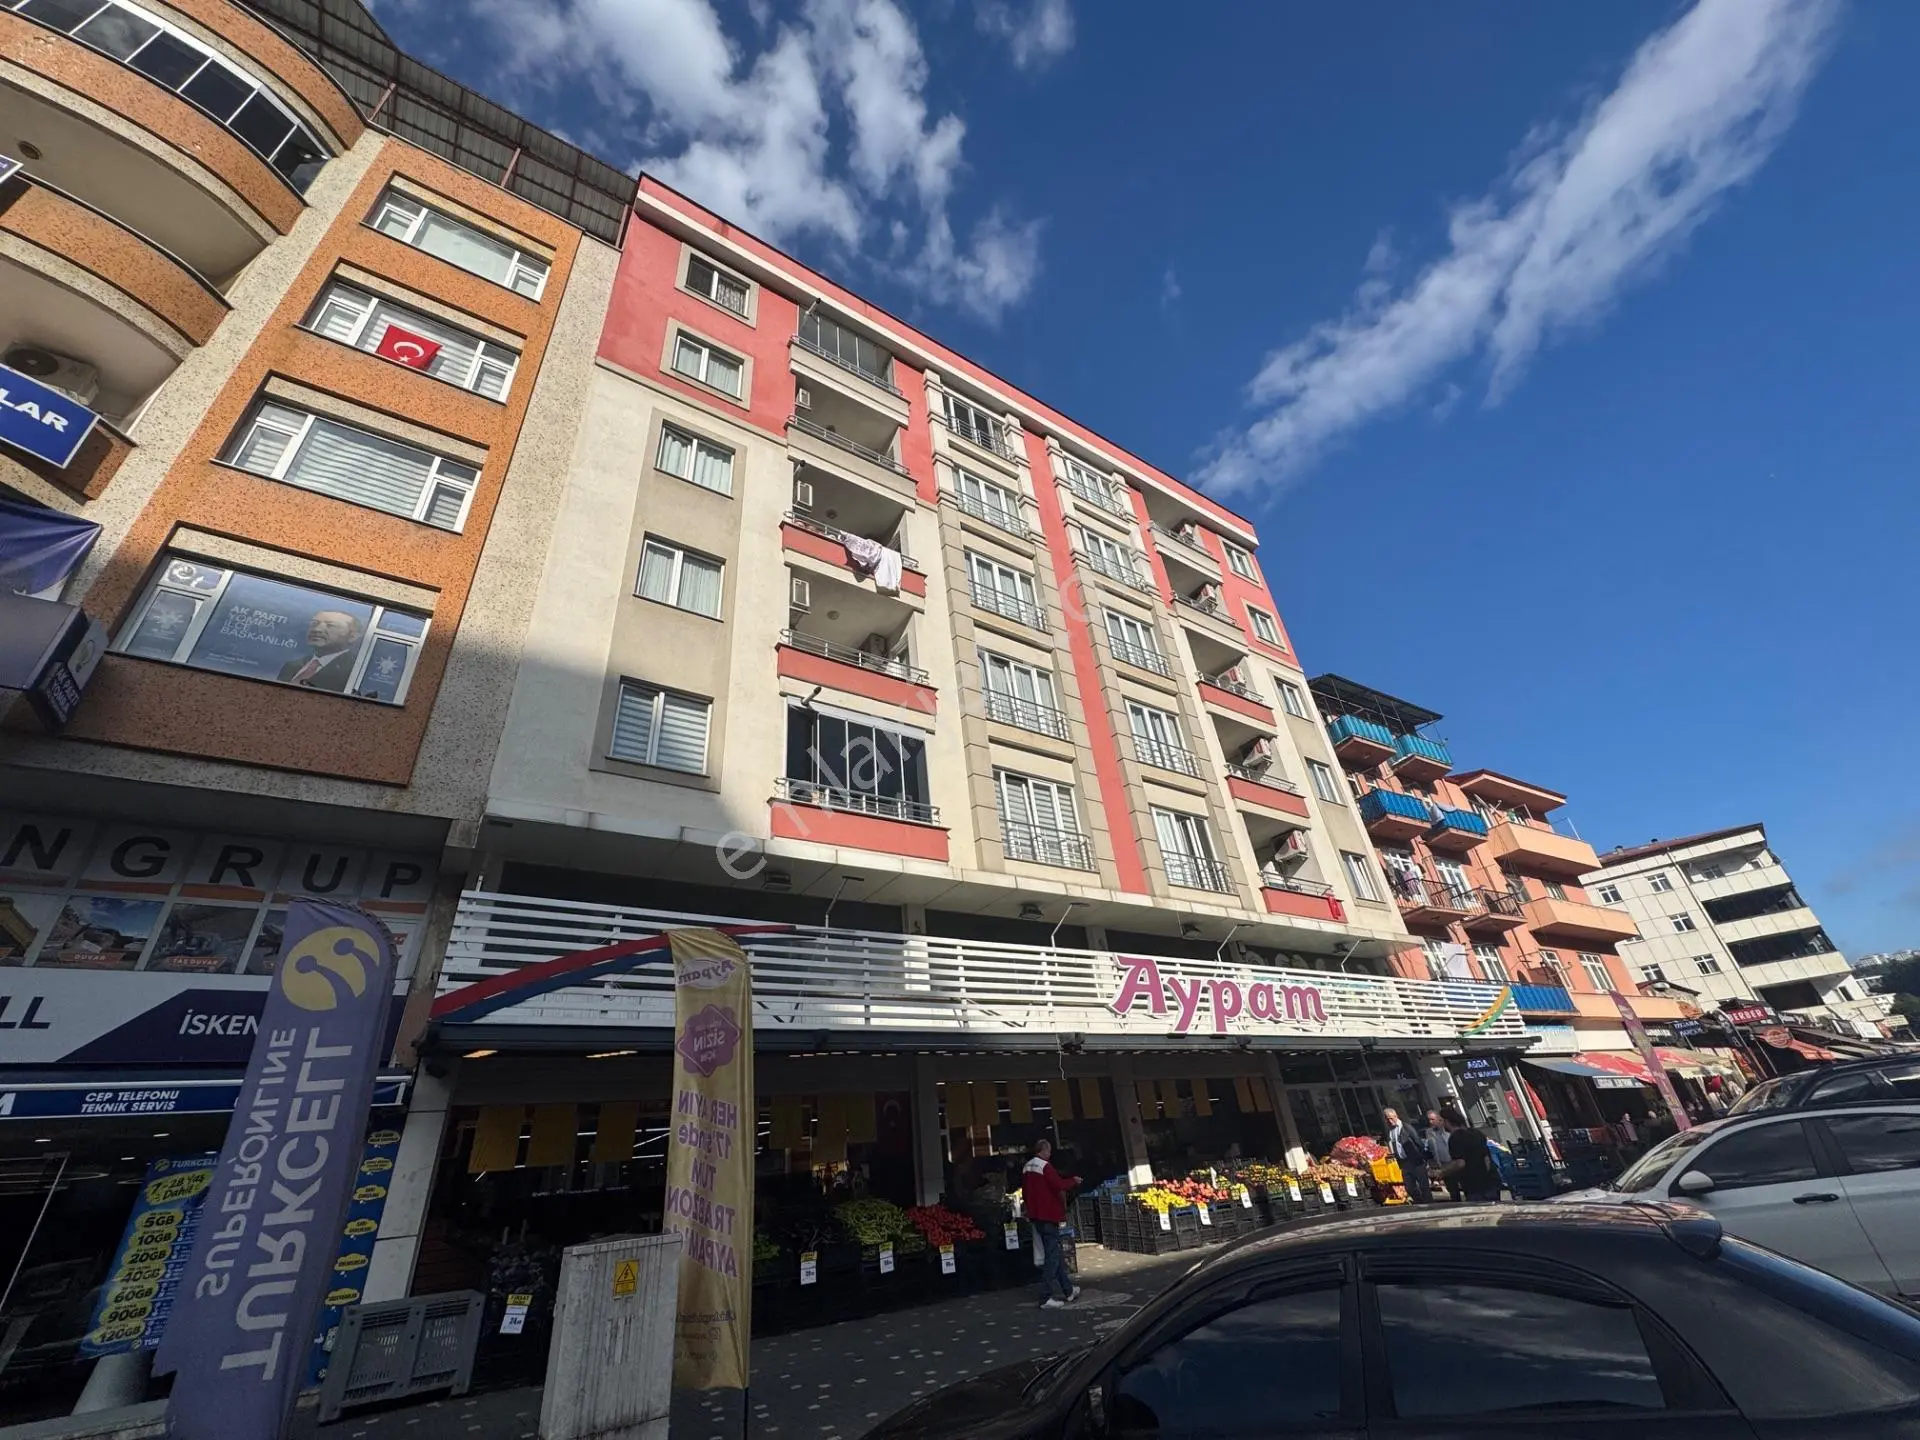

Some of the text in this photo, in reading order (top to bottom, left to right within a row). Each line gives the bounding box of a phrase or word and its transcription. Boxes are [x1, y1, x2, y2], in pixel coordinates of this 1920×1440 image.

[1109, 954, 1330, 1035] Aypam
[85, 1090, 180, 1102] CEP TELEFONU
[143, 1215, 175, 1228] 5GB
[137, 1232, 171, 1246] 10GB
[130, 1249, 166, 1265] 20GB
[114, 1288, 153, 1304] 60GB
[108, 1307, 146, 1322] 90GB
[99, 1326, 141, 1343] 120GB
